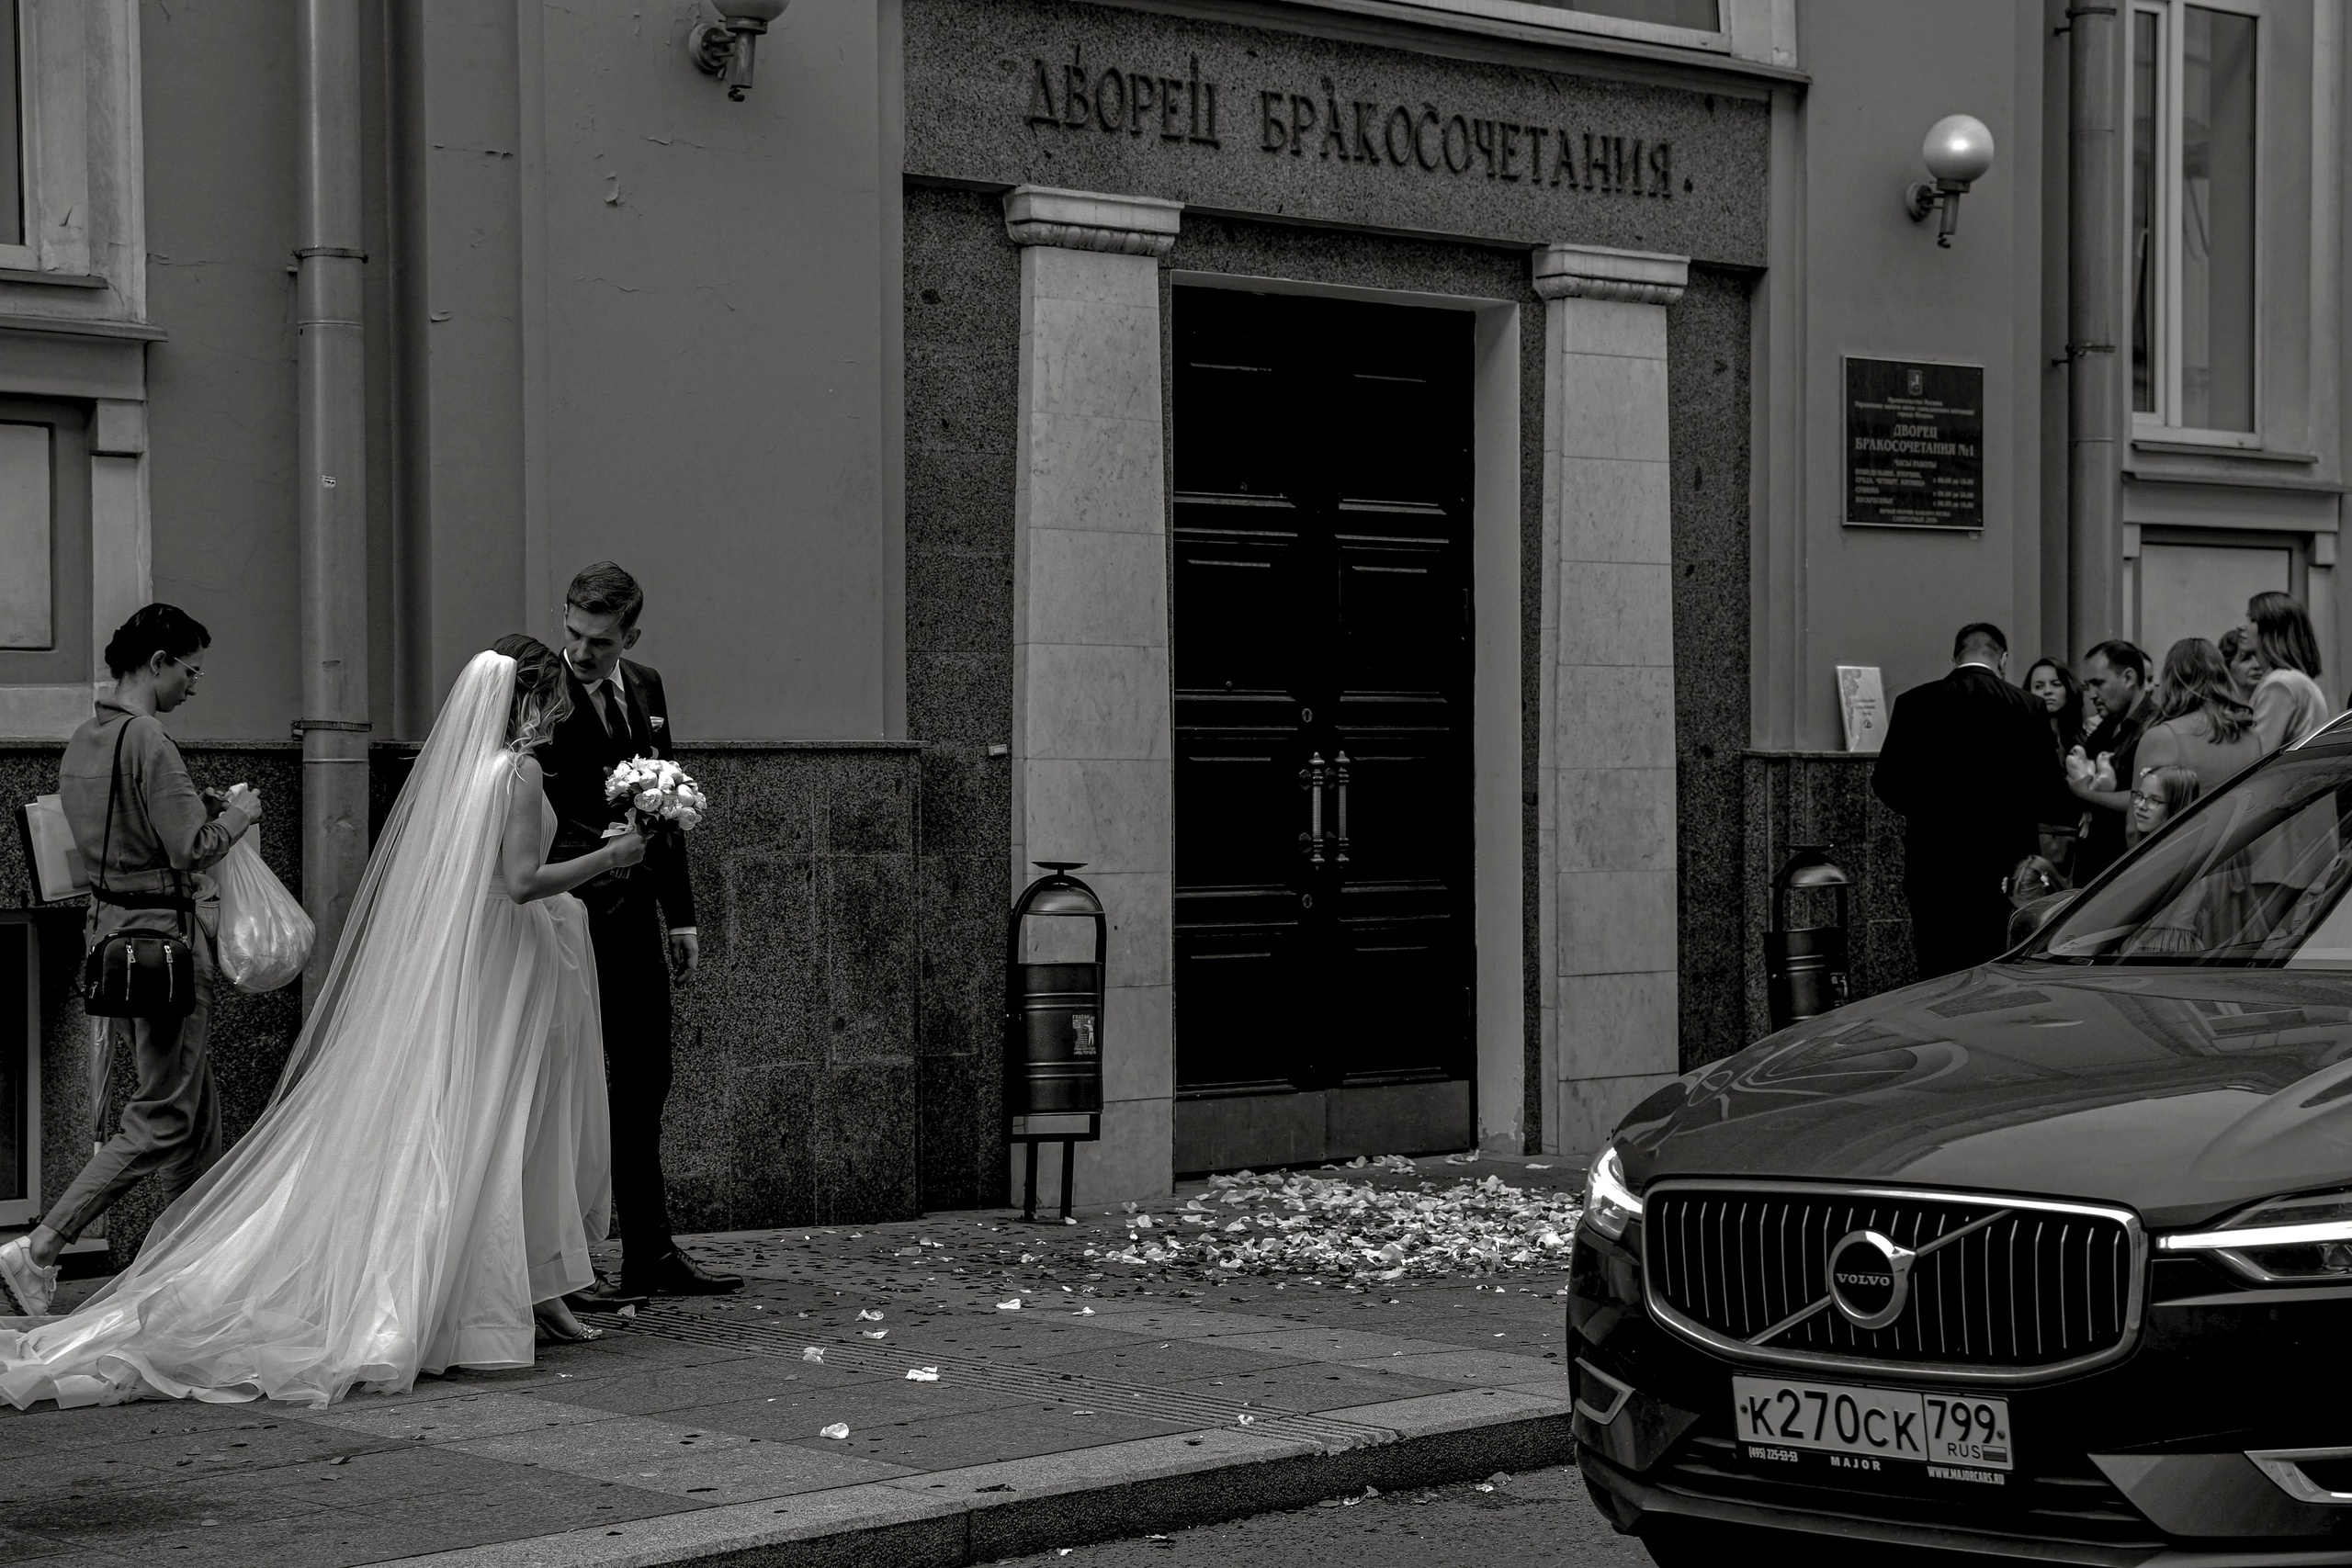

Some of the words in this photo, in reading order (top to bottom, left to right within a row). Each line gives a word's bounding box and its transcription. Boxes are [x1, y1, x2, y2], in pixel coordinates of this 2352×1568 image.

[1025, 59, 1220, 151] ДВОРЕЦ
[1261, 90, 1675, 199] БРАКОСОЧЕТАНИЯ
[1894, 424, 1938, 439] ДВОРЕЦ
[1855, 437, 1956, 456] БРАКОСОЧЕТАНИЯ
[1836, 1273, 1891, 1286] VOLVO
[1927, 1398, 1996, 1445] 799
[1748, 1446, 1767, 1460] (495)
[1947, 1442, 1982, 1460] RUS
[1830, 1455, 1882, 1472] MAJOR
[1927, 1465, 2006, 1485] WWW.MAJORCARS.RU
